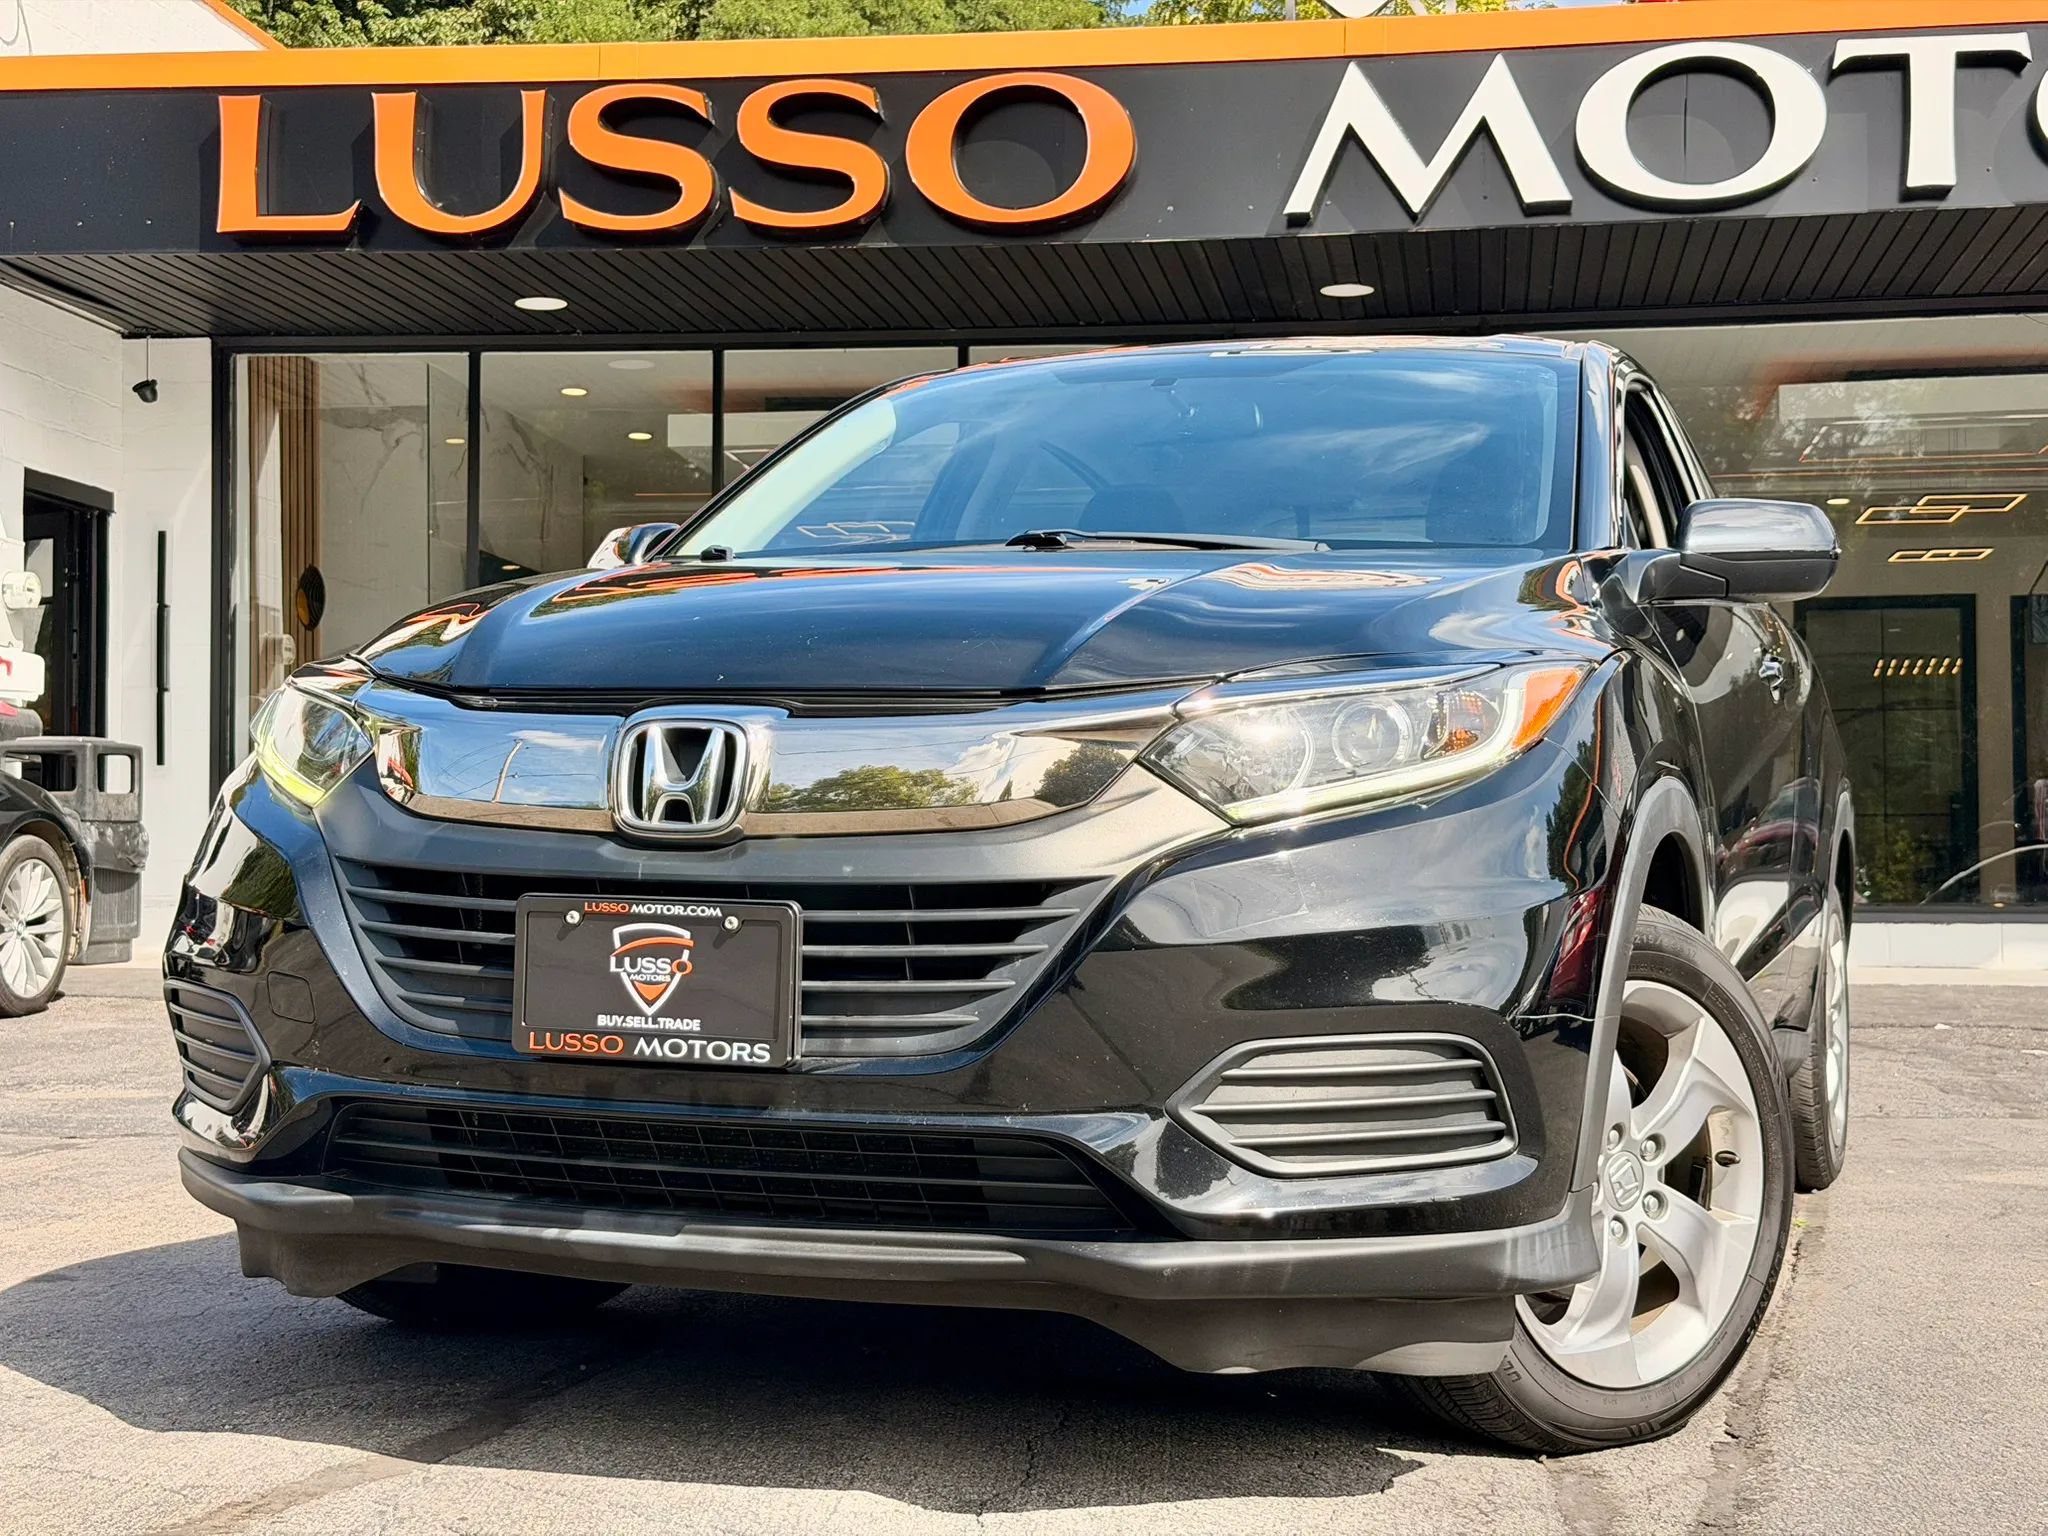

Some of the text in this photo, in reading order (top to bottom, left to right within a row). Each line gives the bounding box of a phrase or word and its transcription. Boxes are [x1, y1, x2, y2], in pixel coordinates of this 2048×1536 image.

[215, 32, 2048, 235] LUSSO MOT
[610, 956, 693, 975] LUSSO
[629, 973, 671, 982] MOTORS
[597, 1014, 701, 1031] BUY.SELL.TRADE
[529, 1031, 771, 1063] LUSSO MOTORS
